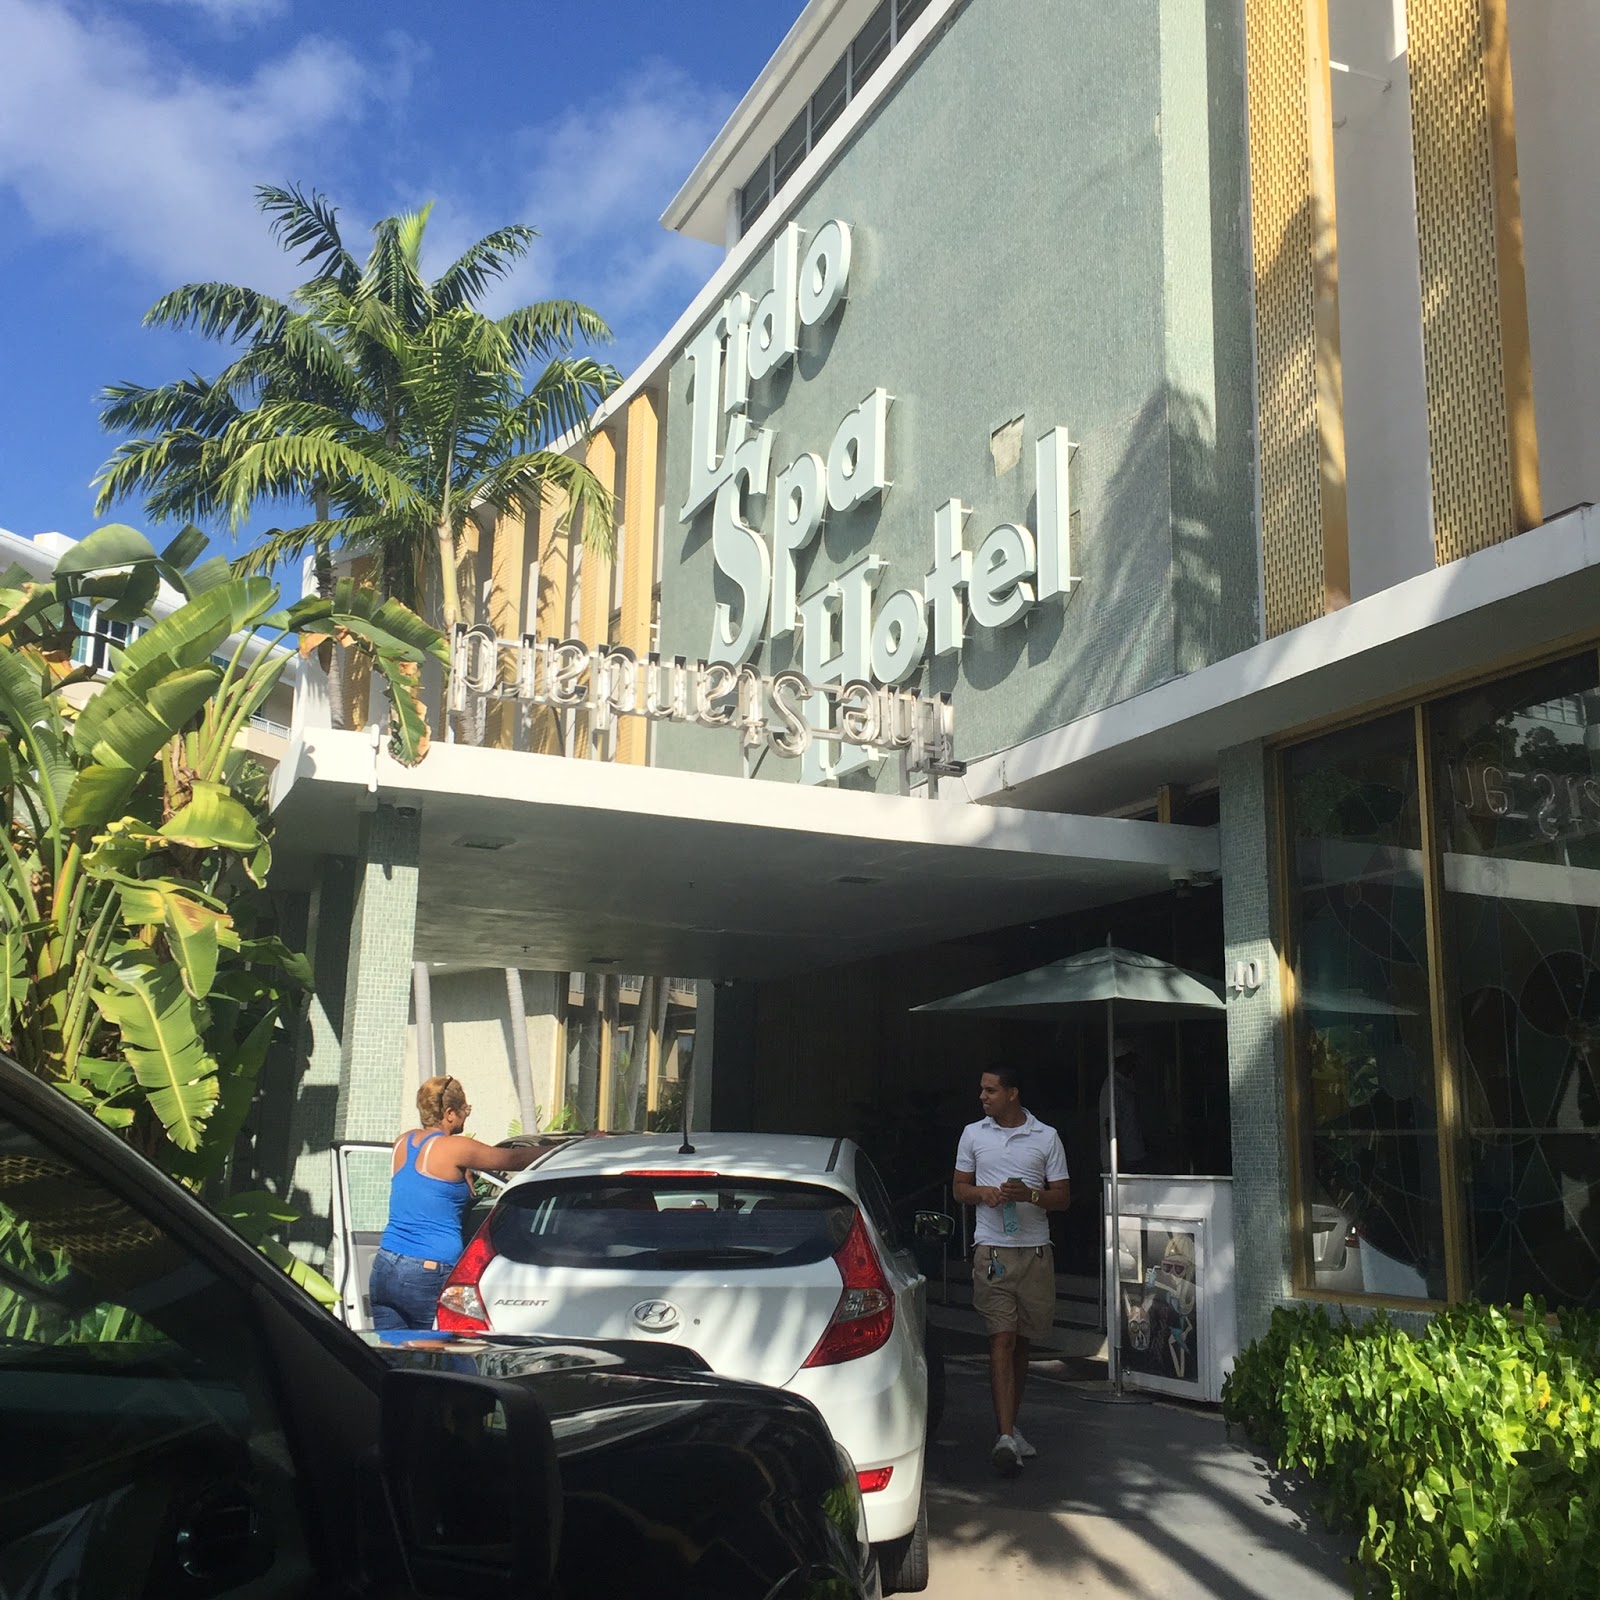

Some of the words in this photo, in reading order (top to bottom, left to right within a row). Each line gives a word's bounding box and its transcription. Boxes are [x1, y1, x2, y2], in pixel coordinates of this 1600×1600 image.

[680, 219, 854, 524] Lido
[708, 387, 889, 668] Spa
[798, 426, 1071, 786] Hotel
[450, 621, 814, 760] Standard
[836, 679, 968, 778] The
[1228, 958, 1262, 991] 40
